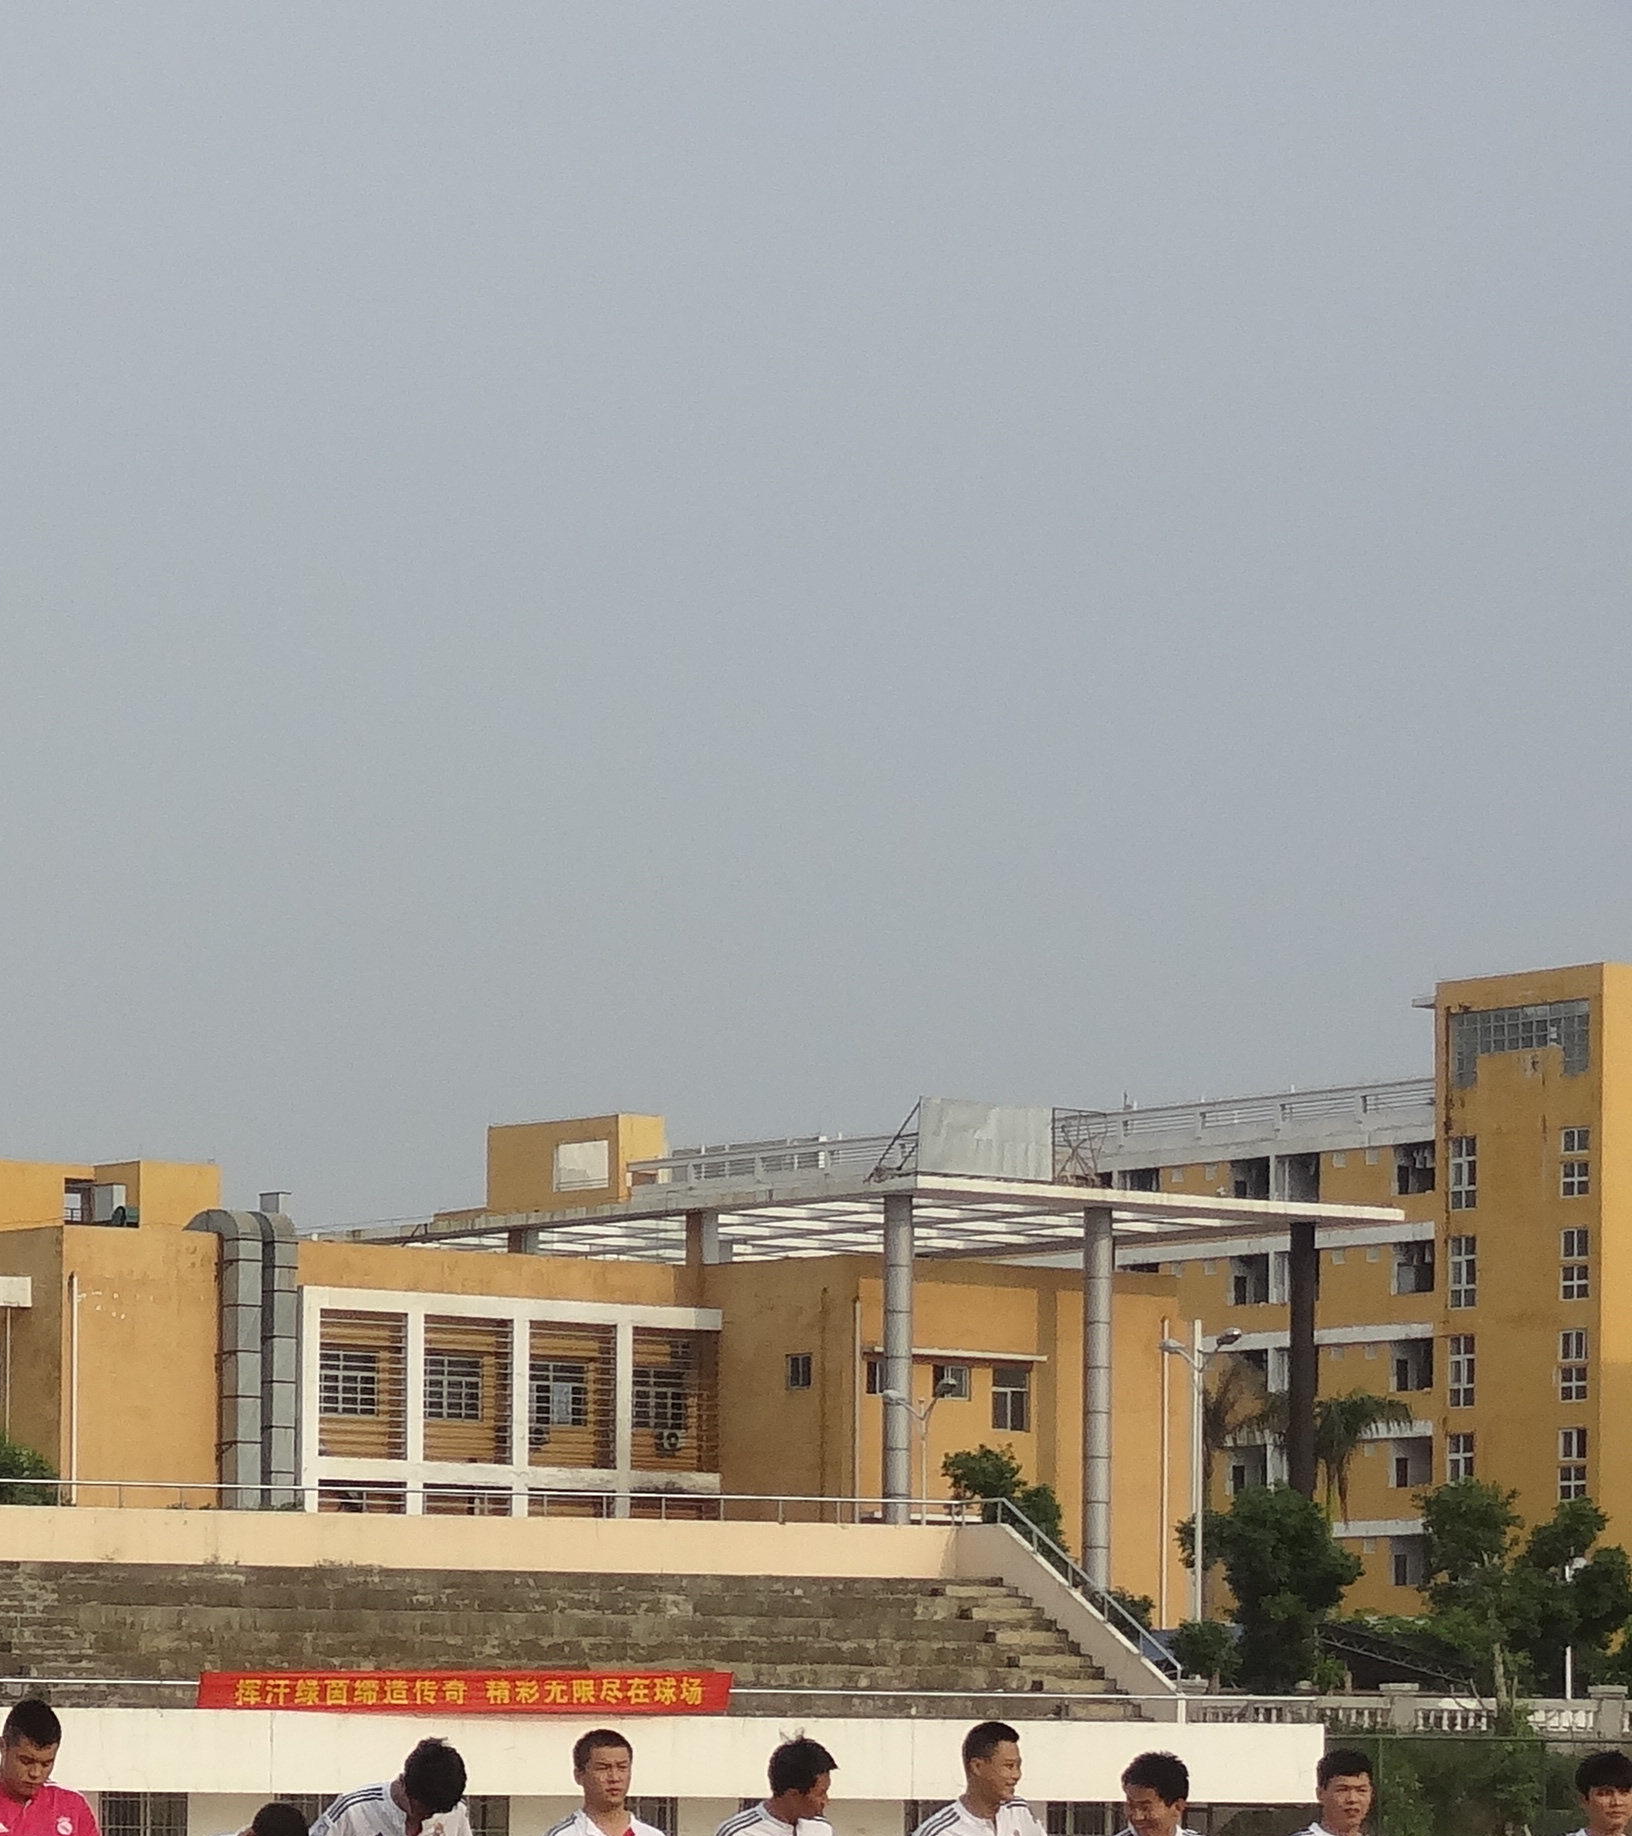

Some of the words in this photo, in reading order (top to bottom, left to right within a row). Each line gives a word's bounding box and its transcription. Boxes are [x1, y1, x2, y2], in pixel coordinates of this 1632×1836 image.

[485, 1677, 703, 1705] 精彩无限尽在球场
